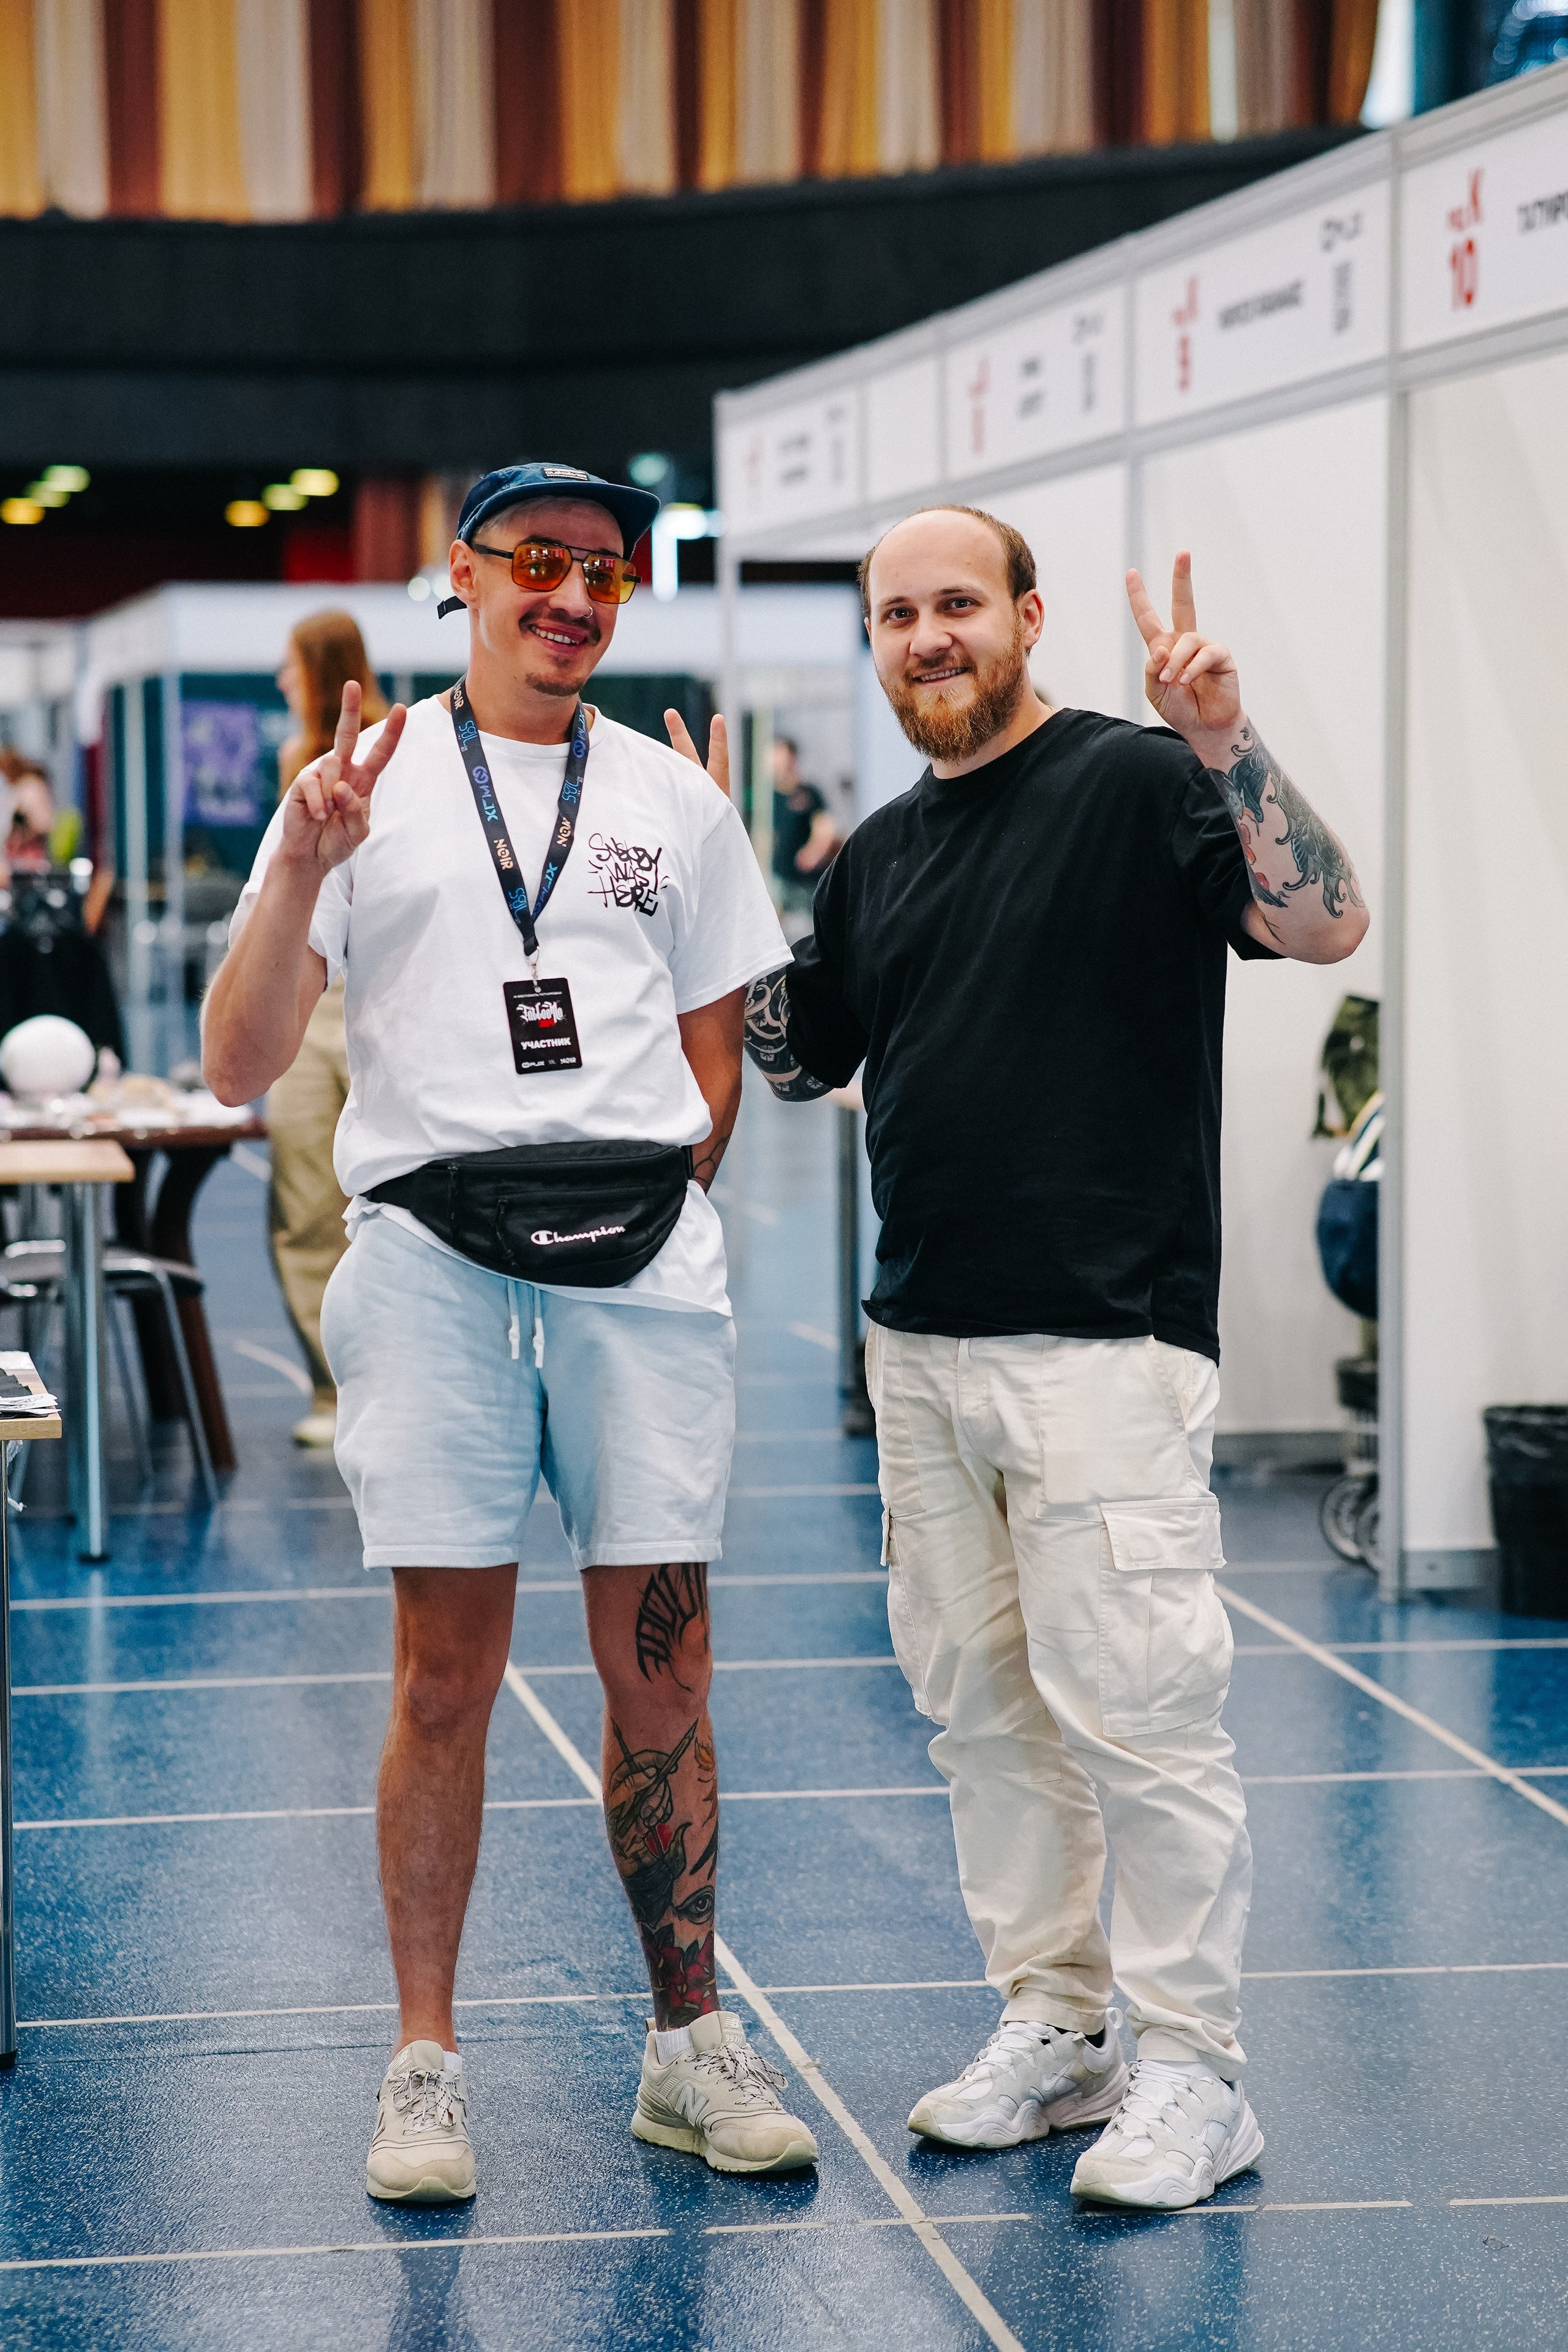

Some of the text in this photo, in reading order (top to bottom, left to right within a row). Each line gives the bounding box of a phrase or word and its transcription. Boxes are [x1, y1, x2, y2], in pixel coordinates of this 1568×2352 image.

[1450, 236, 1479, 311] 10
[493, 839, 514, 870] NOIR
[587, 876, 658, 917] HERE
[520, 1037, 571, 1050] УЧАСТНИК
[530, 1226, 625, 1245] Champion
[725, 2034, 742, 2043] 997H
